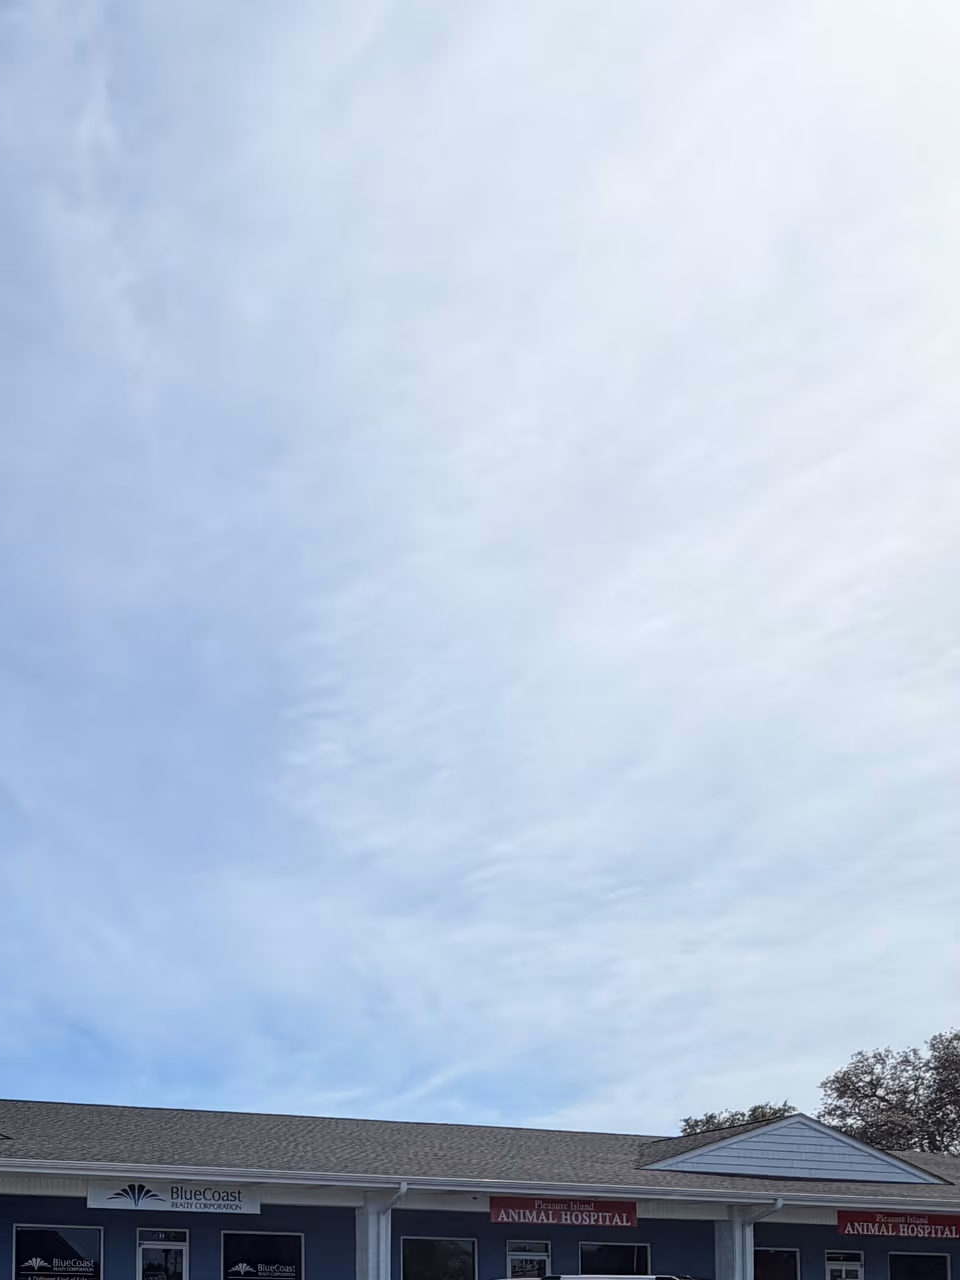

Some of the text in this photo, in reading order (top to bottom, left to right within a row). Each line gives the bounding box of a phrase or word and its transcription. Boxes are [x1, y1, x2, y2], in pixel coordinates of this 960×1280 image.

[170, 1186, 242, 1202] BlueCoast
[194, 1203, 242, 1211] CORPORATION
[534, 1200, 595, 1211] Pleasure Island
[497, 1209, 631, 1226] ANIMAL HOSPITAL
[876, 1214, 929, 1224] Pleasure Island
[844, 1221, 959, 1238] ANIMAL HOSPITAL
[52, 1258, 94, 1267] BlueCoast
[257, 1263, 296, 1272] BlueCoast
